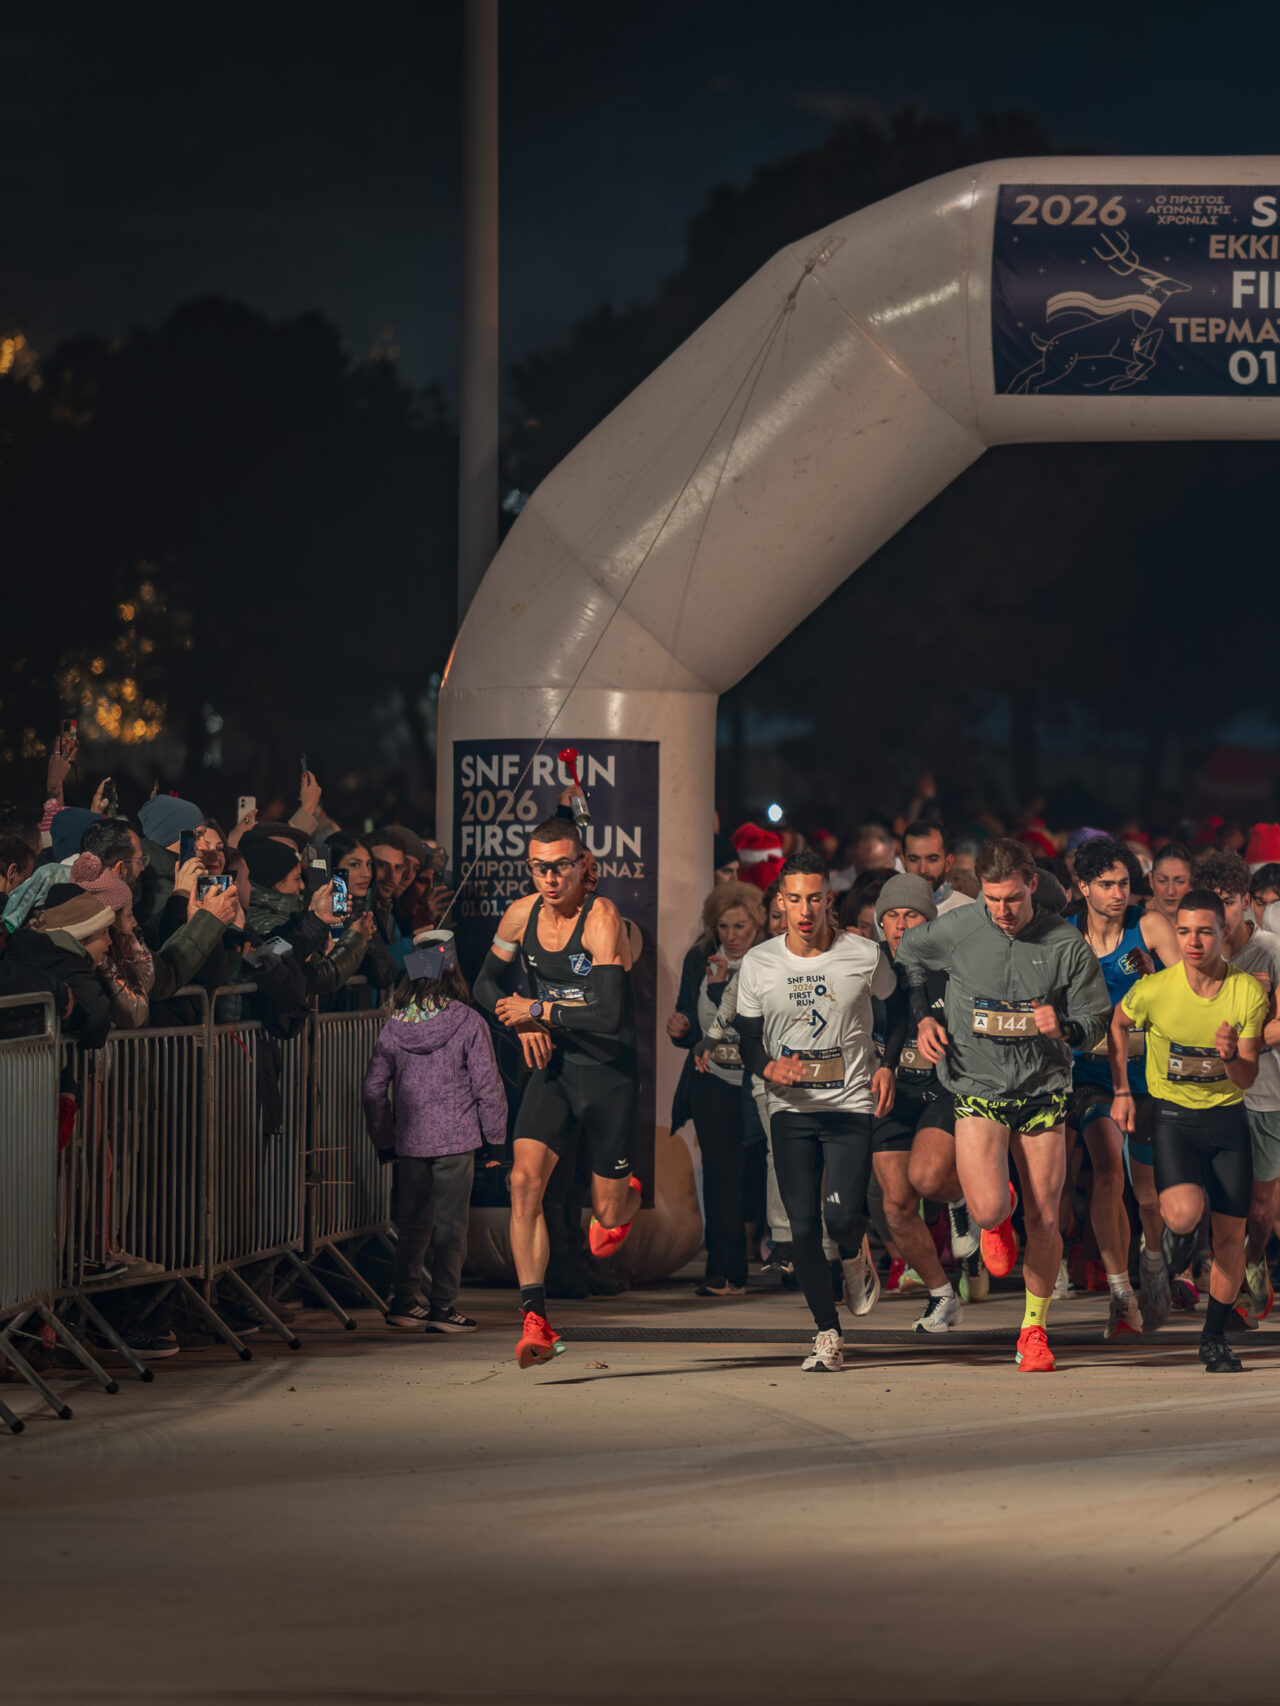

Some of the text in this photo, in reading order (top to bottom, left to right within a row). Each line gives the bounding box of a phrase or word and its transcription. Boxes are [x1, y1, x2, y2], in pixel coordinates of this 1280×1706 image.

[1169, 195, 1225, 205] ΠΡΩΤΟΣ
[1012, 194, 1127, 227] 2026
[1146, 205, 1232, 215] ΑΓΩΝΑΣ ΤΗΣ
[1157, 215, 1219, 225] ΧΡΟΝΙΑΣ
[460, 754, 616, 788] SNF RUN
[460, 789, 539, 822] 2026
[576, 825, 642, 859] UN
[787, 974, 826, 985] SNF RUN
[792, 984, 814, 992] 2026
[788, 991, 812, 1000] FIRST
[796, 998, 815, 1007] RUN
[996, 1015, 1028, 1032] 144
[809, 1063, 822, 1078] 7
[1200, 1060, 1213, 1074] 5
